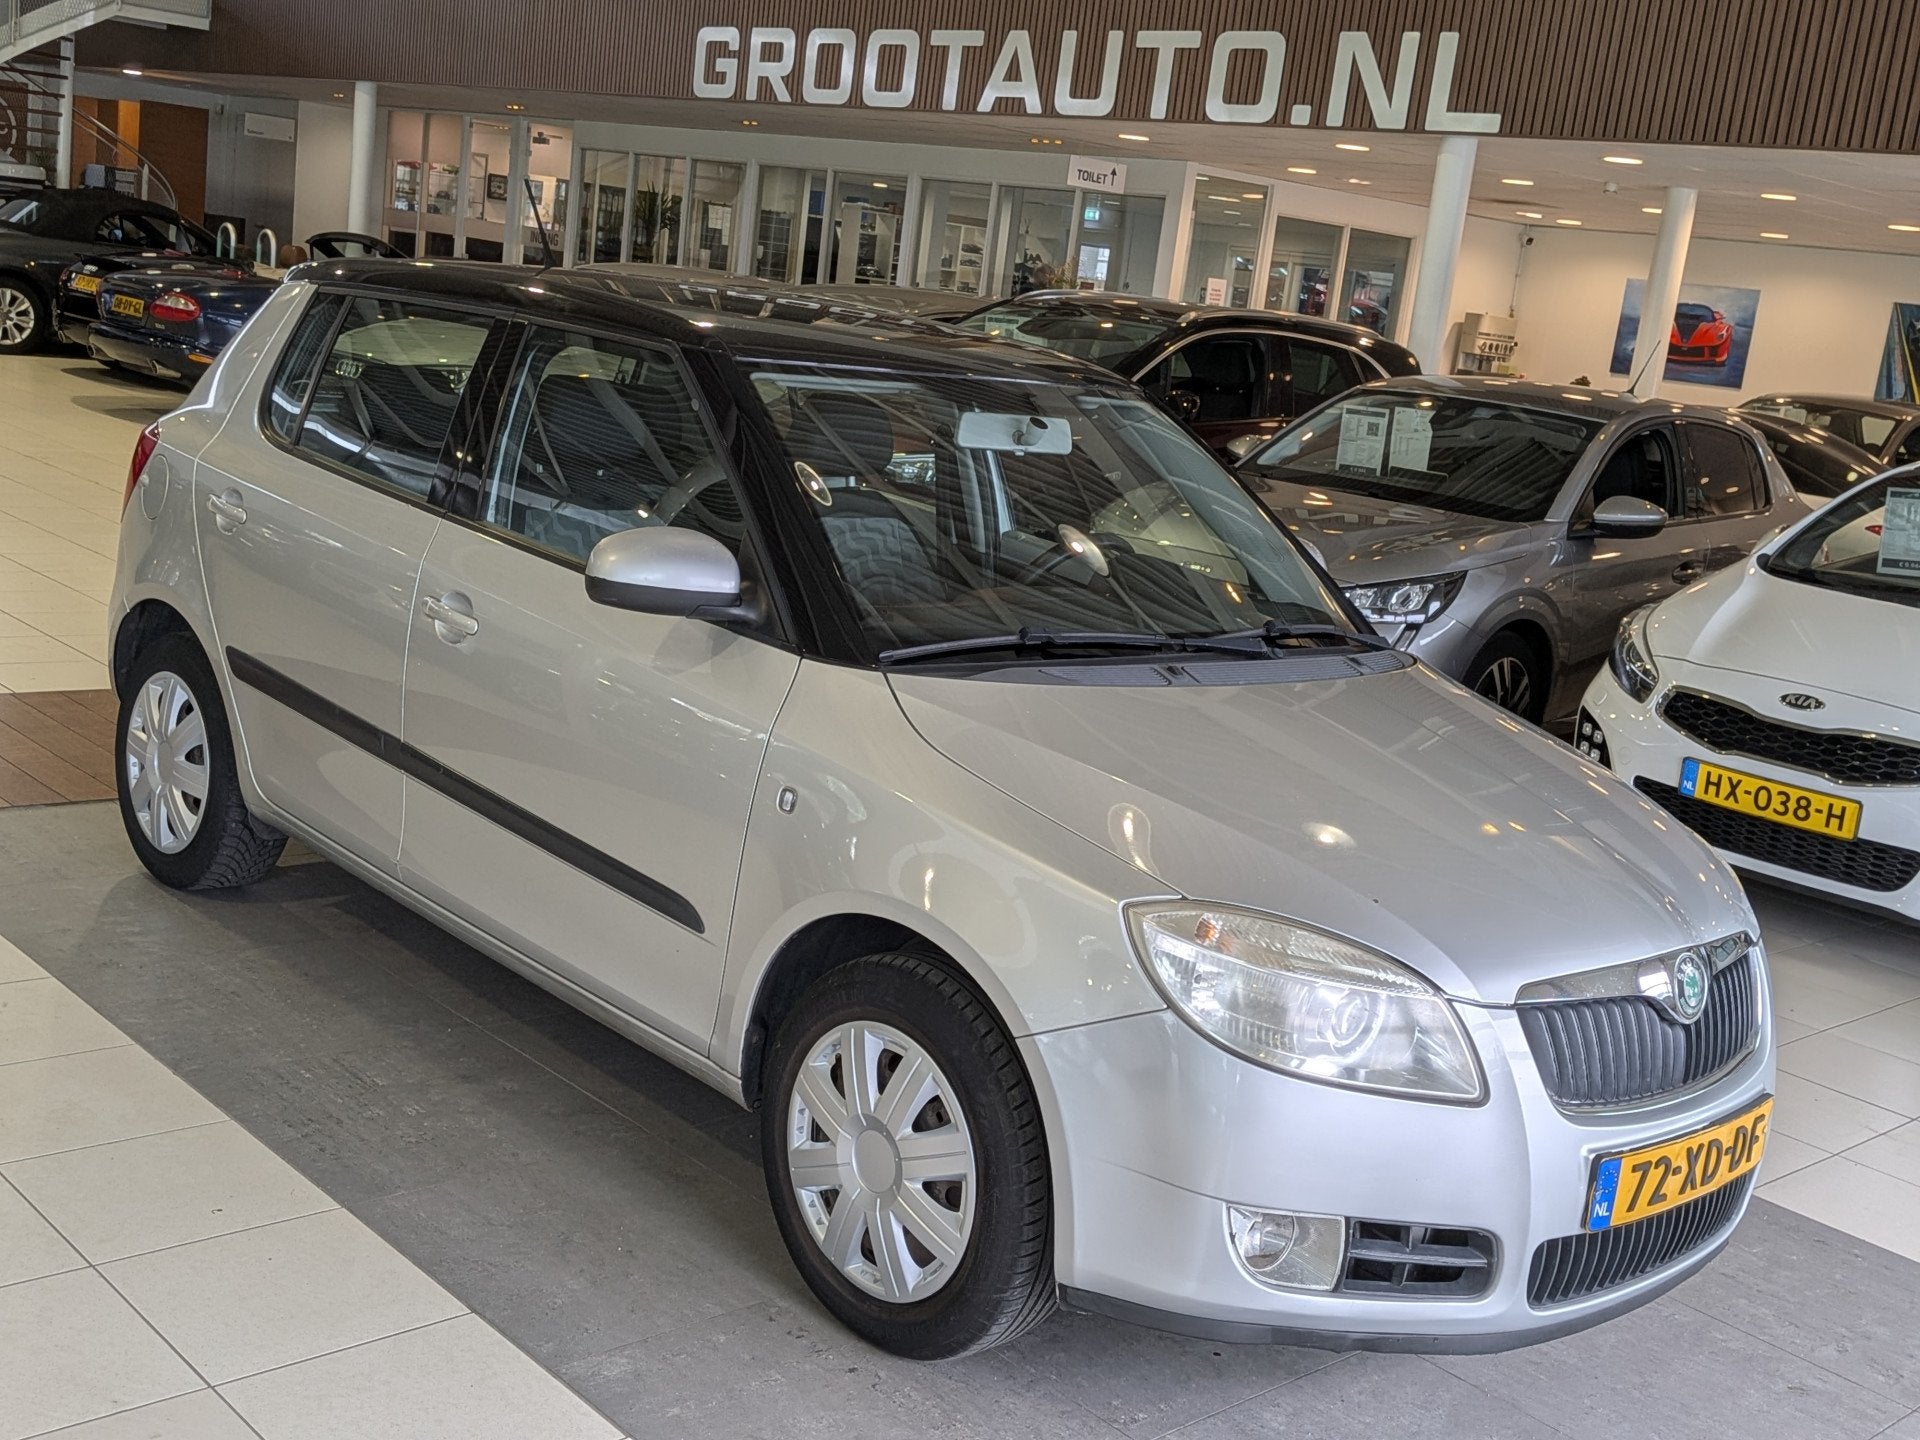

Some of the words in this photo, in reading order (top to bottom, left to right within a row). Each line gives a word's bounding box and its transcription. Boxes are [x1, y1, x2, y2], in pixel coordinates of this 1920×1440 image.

[693, 26, 1501, 133] GROOTAUTO.NL
[1077, 168, 1108, 185] TOILET
[530, 230, 559, 247] INGNG
[1785, 694, 1816, 710] KIA
[1682, 780, 1694, 791] NL
[1703, 770, 1847, 832] HX-038-H
[1625, 1113, 1766, 1213] 72-XD-DF
[1593, 1201, 1610, 1218] NL
